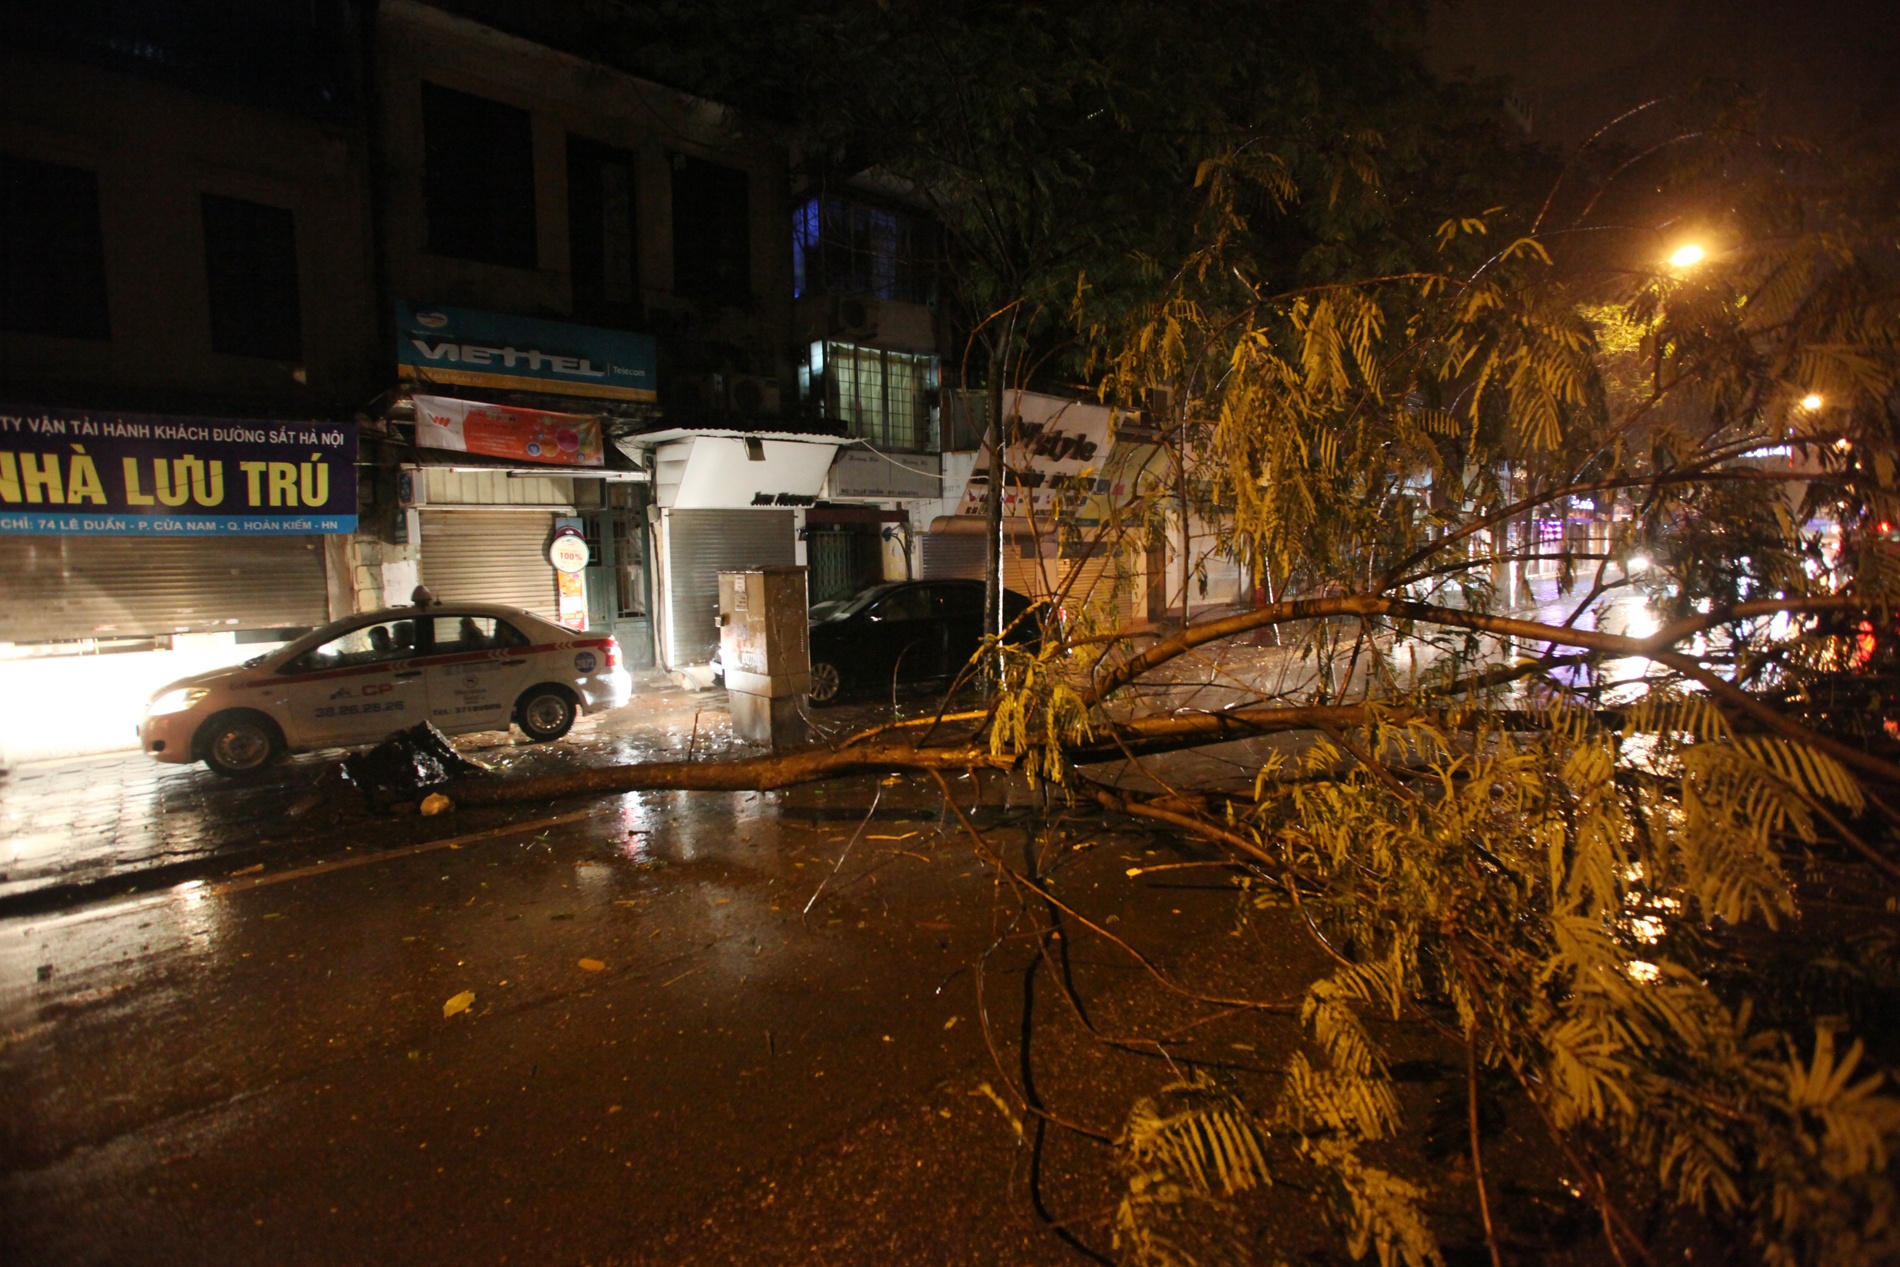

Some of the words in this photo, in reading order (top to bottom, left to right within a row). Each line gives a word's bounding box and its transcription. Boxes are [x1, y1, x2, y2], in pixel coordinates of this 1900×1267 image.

[613, 365, 646, 377] Telecom
[0, 415, 22, 432] TY
[26, 415, 66, 437] VẬN
[70, 416, 98, 436] TẢI
[103, 418, 150, 438] HÀNH
[154, 420, 209, 441] KHÁCH
[212, 424, 266, 443] ĐƯỜNG
[269, 425, 296, 444] SẮT
[299, 429, 318, 445] HÀ
[321, 429, 345, 448] NỘI
[122, 453, 225, 507] LƯU
[239, 452, 329, 508] TRÚ
[1, 516, 34, 530] CHỈ:
[38, 519, 56, 530] 74
[60, 517, 79, 530] LÊ
[87, 516, 126, 531] DUẨN
[138, 521, 150, 531] P.
[153, 518, 183, 531] CỬA
[186, 521, 217, 531] NAM
[227, 521, 241, 531] Q.
[244, 518, 278, 531] HOÀN
[282, 517, 312, 530] KIẾM
[321, 520, 338, 530] HN
[560, 552, 583, 561] 100%
[361, 683, 394, 696] CP
